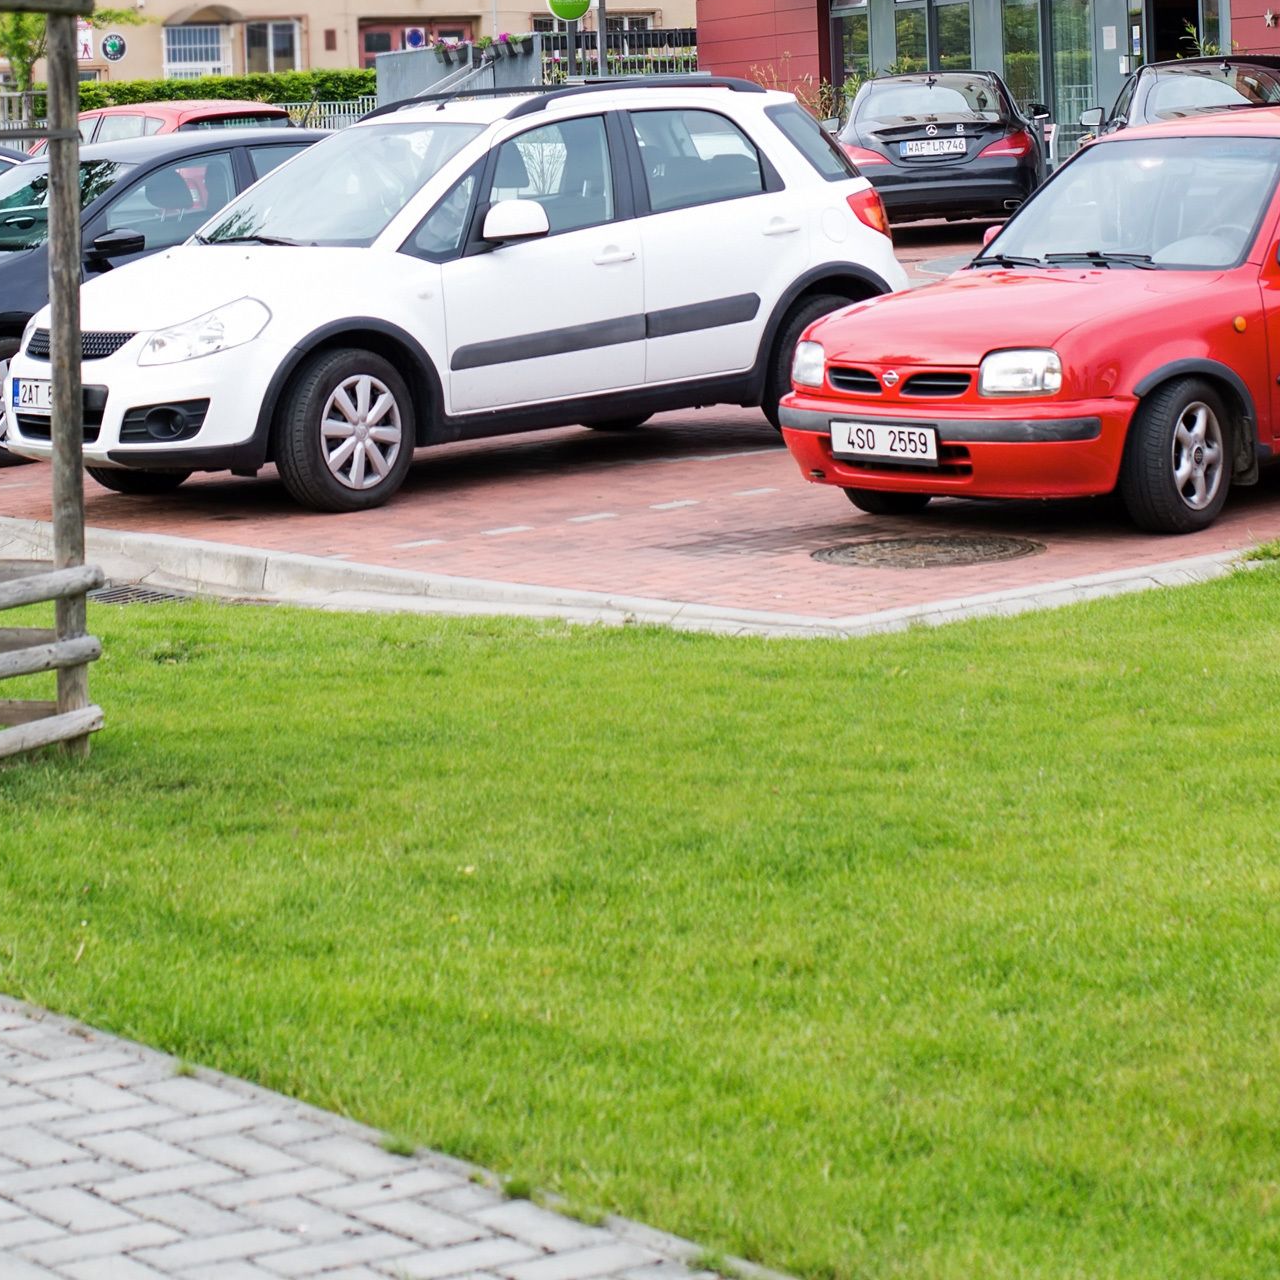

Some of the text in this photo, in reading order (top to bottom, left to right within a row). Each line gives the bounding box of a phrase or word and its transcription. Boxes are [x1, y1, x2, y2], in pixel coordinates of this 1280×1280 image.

[907, 142, 926, 153] WAF
[21, 384, 40, 405] 2AT
[888, 430, 928, 454] 2559
